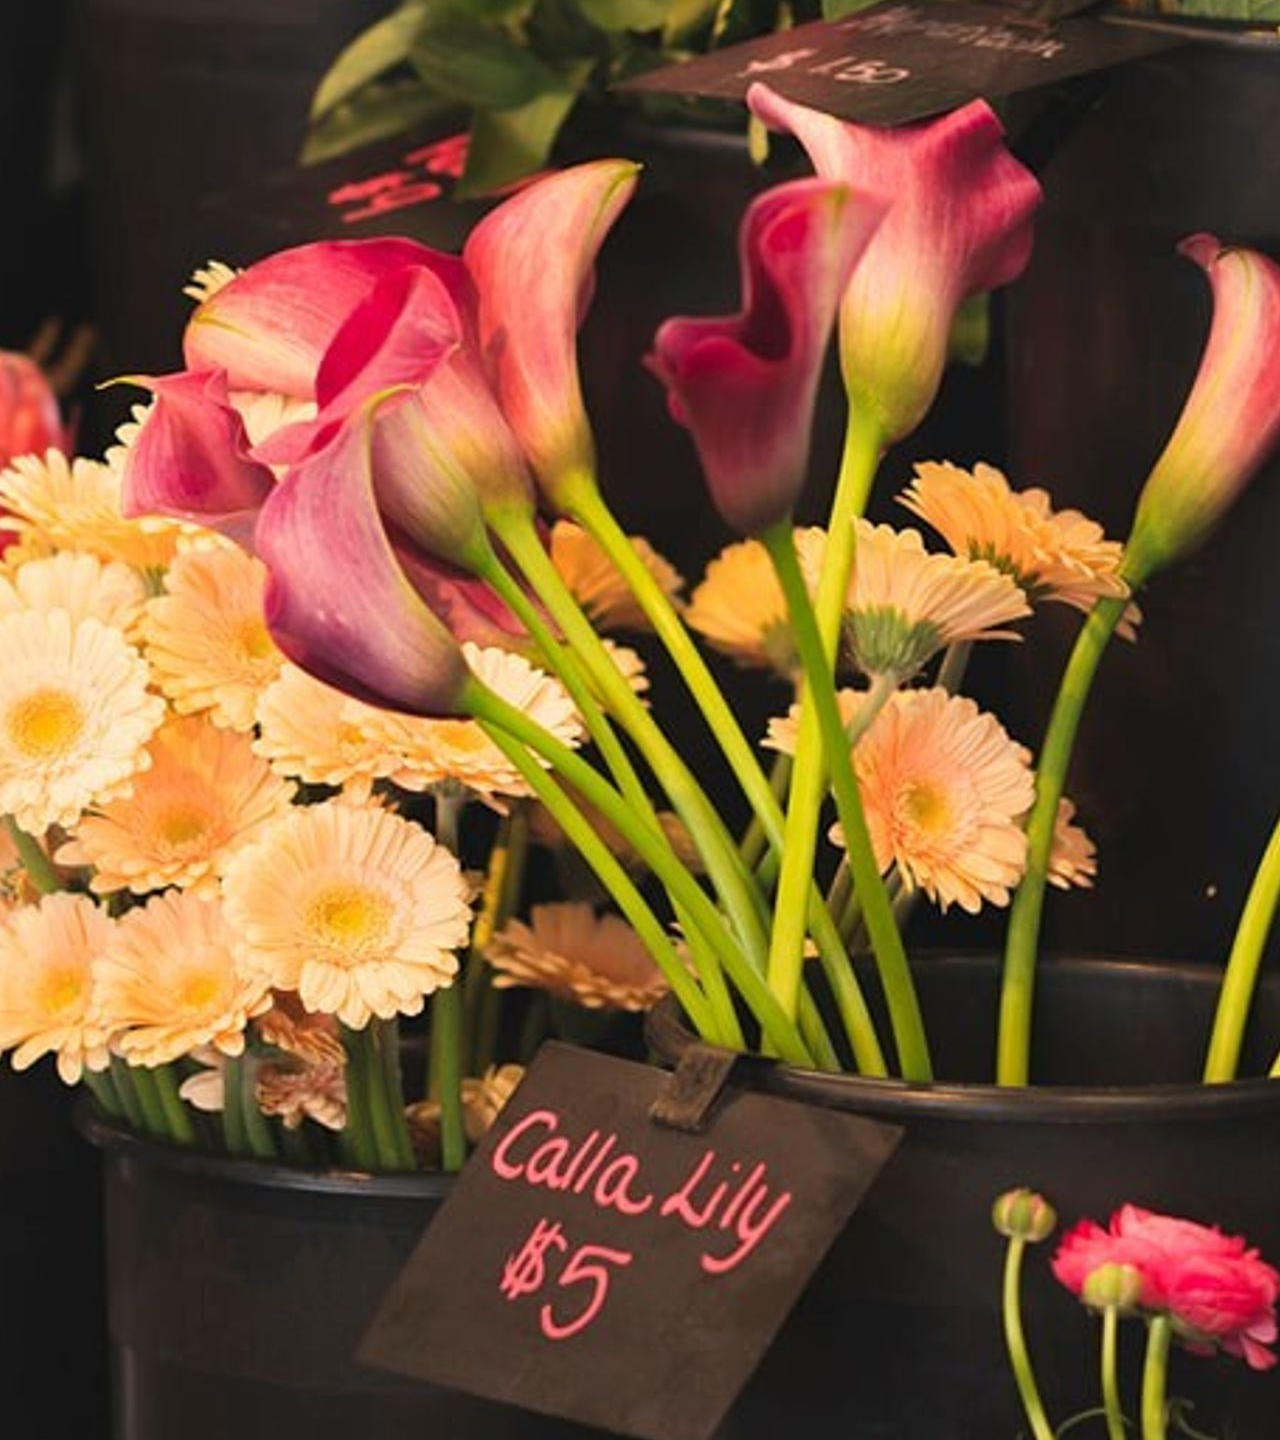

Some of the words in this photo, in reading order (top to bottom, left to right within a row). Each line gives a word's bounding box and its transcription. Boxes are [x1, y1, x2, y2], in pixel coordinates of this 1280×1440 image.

[491, 1110, 654, 1215] Calla
[660, 1149, 792, 1274] Lily
[500, 1218, 632, 1340] $5
